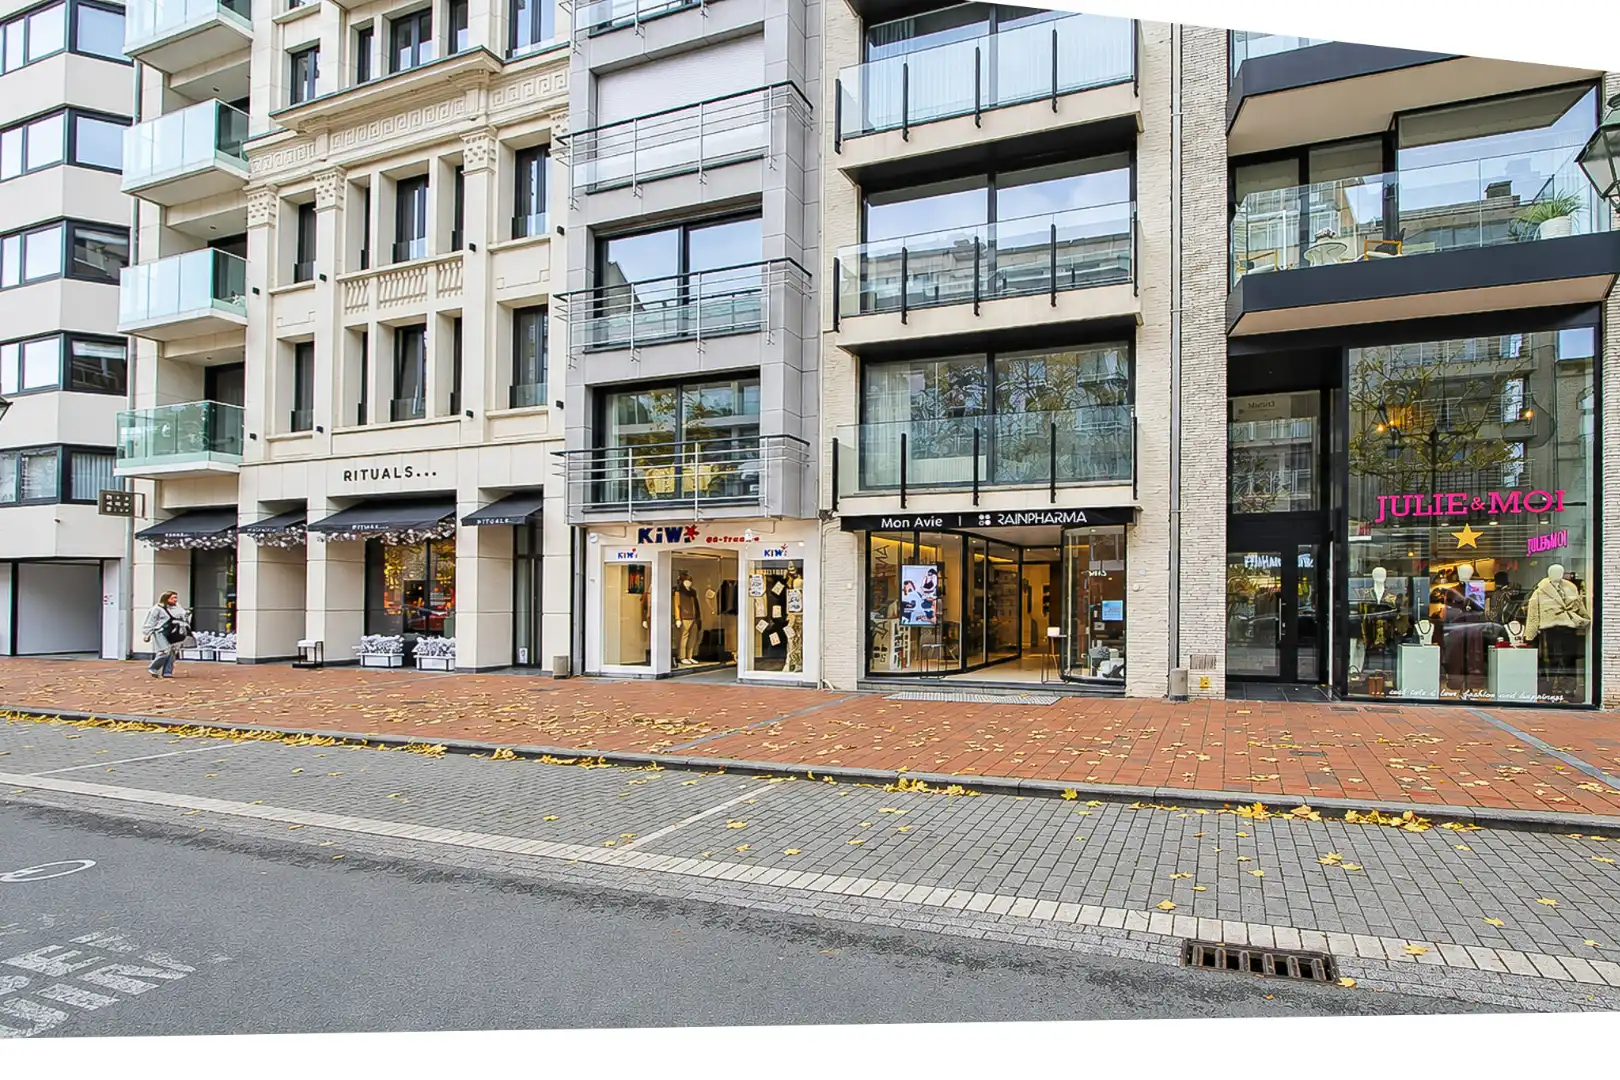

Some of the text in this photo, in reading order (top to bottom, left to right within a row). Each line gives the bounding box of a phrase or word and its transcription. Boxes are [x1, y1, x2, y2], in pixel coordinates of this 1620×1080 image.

[344, 466, 437, 481] RITUALS...
[881, 516, 943, 528] Mon Avie
[997, 511, 1088, 525] RAINPHARMA
